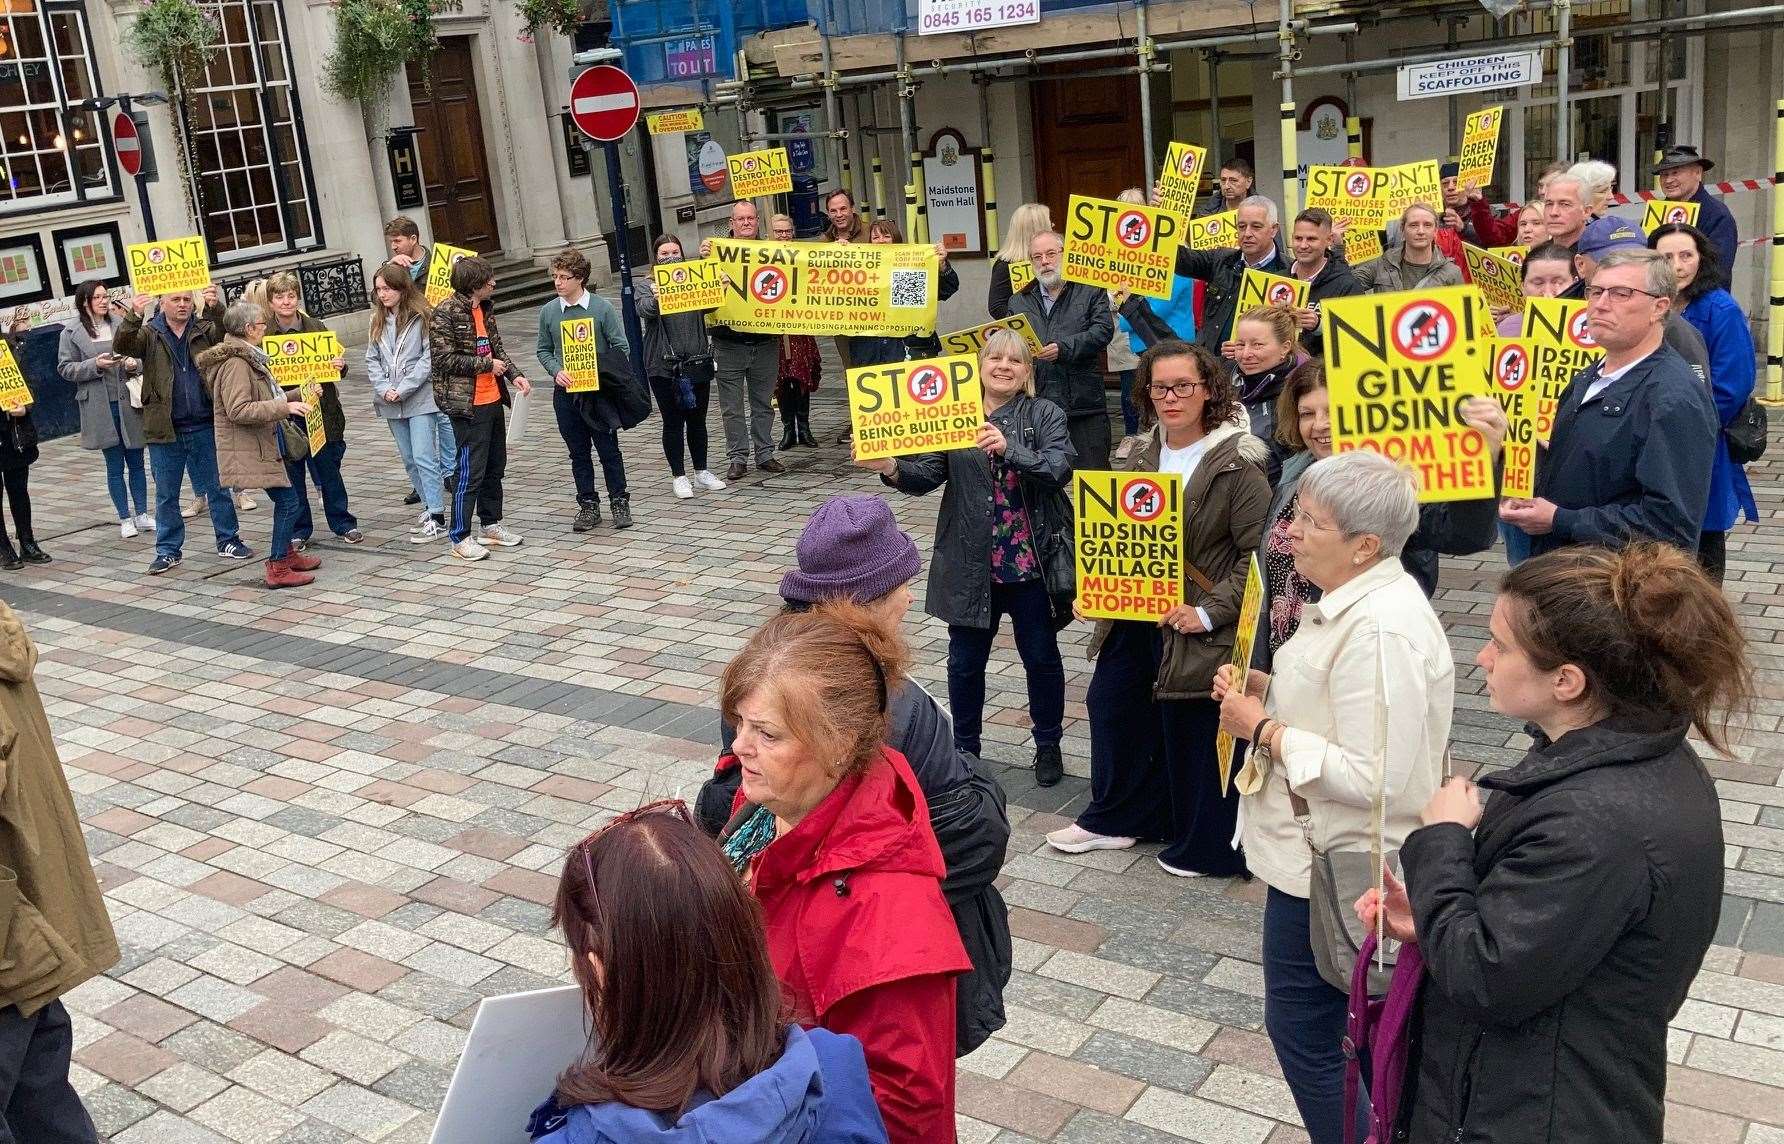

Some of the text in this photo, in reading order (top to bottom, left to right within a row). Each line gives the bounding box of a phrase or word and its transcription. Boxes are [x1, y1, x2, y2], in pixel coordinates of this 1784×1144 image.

[924, 2, 1035, 28] 0845 165 1234
[671, 62, 687, 75] TO
[1420, 62, 1520, 79] KEEP OFF THIS
[1436, 56, 1505, 70] CHILDREN
[1418, 70, 1521, 91] SCAFFOLDING
[1466, 110, 1500, 135] STOP
[1463, 138, 1495, 157] GREEN
[394, 148, 412, 173] H
[730, 152, 784, 175] DON'T
[1165, 146, 1203, 180] NO!
[1461, 152, 1493, 171] SPACES
[733, 171, 767, 182] DESTROY
[770, 168, 787, 176] OUR
[734, 176, 788, 190] IMPORTANT
[1161, 174, 1195, 193] LIDSING
[1312, 170, 1389, 198] STOP
[1397, 165, 1435, 188] N'T
[735, 182, 790, 196] COUNTRYSIDE!
[928, 185, 975, 195] Maidstone
[1160, 187, 1193, 205] GARDEN
[1414, 184, 1438, 194] OUR
[931, 197, 975, 208] Town Hall
[1345, 199, 1385, 209] HOUSES
[1389, 192, 1438, 207] ORTANT
[1340, 208, 1366, 217] BUILT
[1367, 209, 1383, 217] ON
[1072, 202, 1176, 252] STOP
[1193, 214, 1238, 240] DON
[1355, 230, 1375, 242] OUR
[1193, 232, 1231, 248] DESTROY
[131, 241, 200, 267] DON'T
[717, 246, 800, 265] WE SAY
[808, 250, 881, 260] OPPOSE THE
[1070, 240, 1170, 268] 2,000+ HOUSES
[1348, 246, 1380, 261] RYSIDE!
[134, 260, 204, 276] DESTROY OUR
[438, 267, 451, 277] GI
[808, 260, 881, 269] BUILDING OF
[1011, 264, 1031, 282] ST
[1066, 265, 1089, 279] OUR
[1067, 253, 1168, 281] BEING BUILT ON
[1466, 249, 1518, 287] DON'
[136, 268, 205, 285] IMPORTANT
[429, 275, 449, 288] LIDS
[657, 262, 718, 286] DON'T
[808, 269, 880, 285] 2,000+
[137, 277, 207, 292] COUNTRYSIDE!
[660, 280, 720, 294] DESTROY OUR
[721, 265, 798, 304] NO!
[807, 286, 879, 296] NEW HOMES
[661, 288, 721, 303] IMPORTANT
[662, 297, 723, 310] COUNTRYSIDE!
[807, 296, 878, 306] IN LIDSING
[754, 309, 886, 321] GET INVOLVED NOW!
[562, 321, 593, 344] NO!
[1329, 296, 1476, 368] NO!
[266, 335, 333, 357] DON'T
[564, 343, 593, 354] LIDSING
[268, 356, 312, 366] DESTROY
[565, 353, 595, 362] GARDEN
[565, 361, 595, 371] VILLAGE
[1542, 347, 1600, 367] DSIN
[273, 362, 337, 375] MPORTAN
[0, 377, 24, 391] PACES
[571, 379, 597, 388] TOPPED!
[856, 361, 973, 413] STOP
[1357, 365, 1455, 399] GIVE
[858, 401, 977, 428] 2,000+ HOUSES
[859, 415, 977, 441] BEING BUILT ON
[860, 429, 980, 454] OUR DOORSTEPS!
[1444, 429, 1484, 459] TO
[1511, 446, 1531, 467] TO
[1419, 459, 1486, 490] THE!
[1079, 477, 1177, 522] NO!
[1080, 521, 1177, 542] LIDSING
[1080, 540, 1178, 560] GARDEN
[1080, 558, 1178, 579] VILLAGE
[1082, 576, 1178, 596] MUST BE
[1082, 593, 1178, 615] STOPPED!
